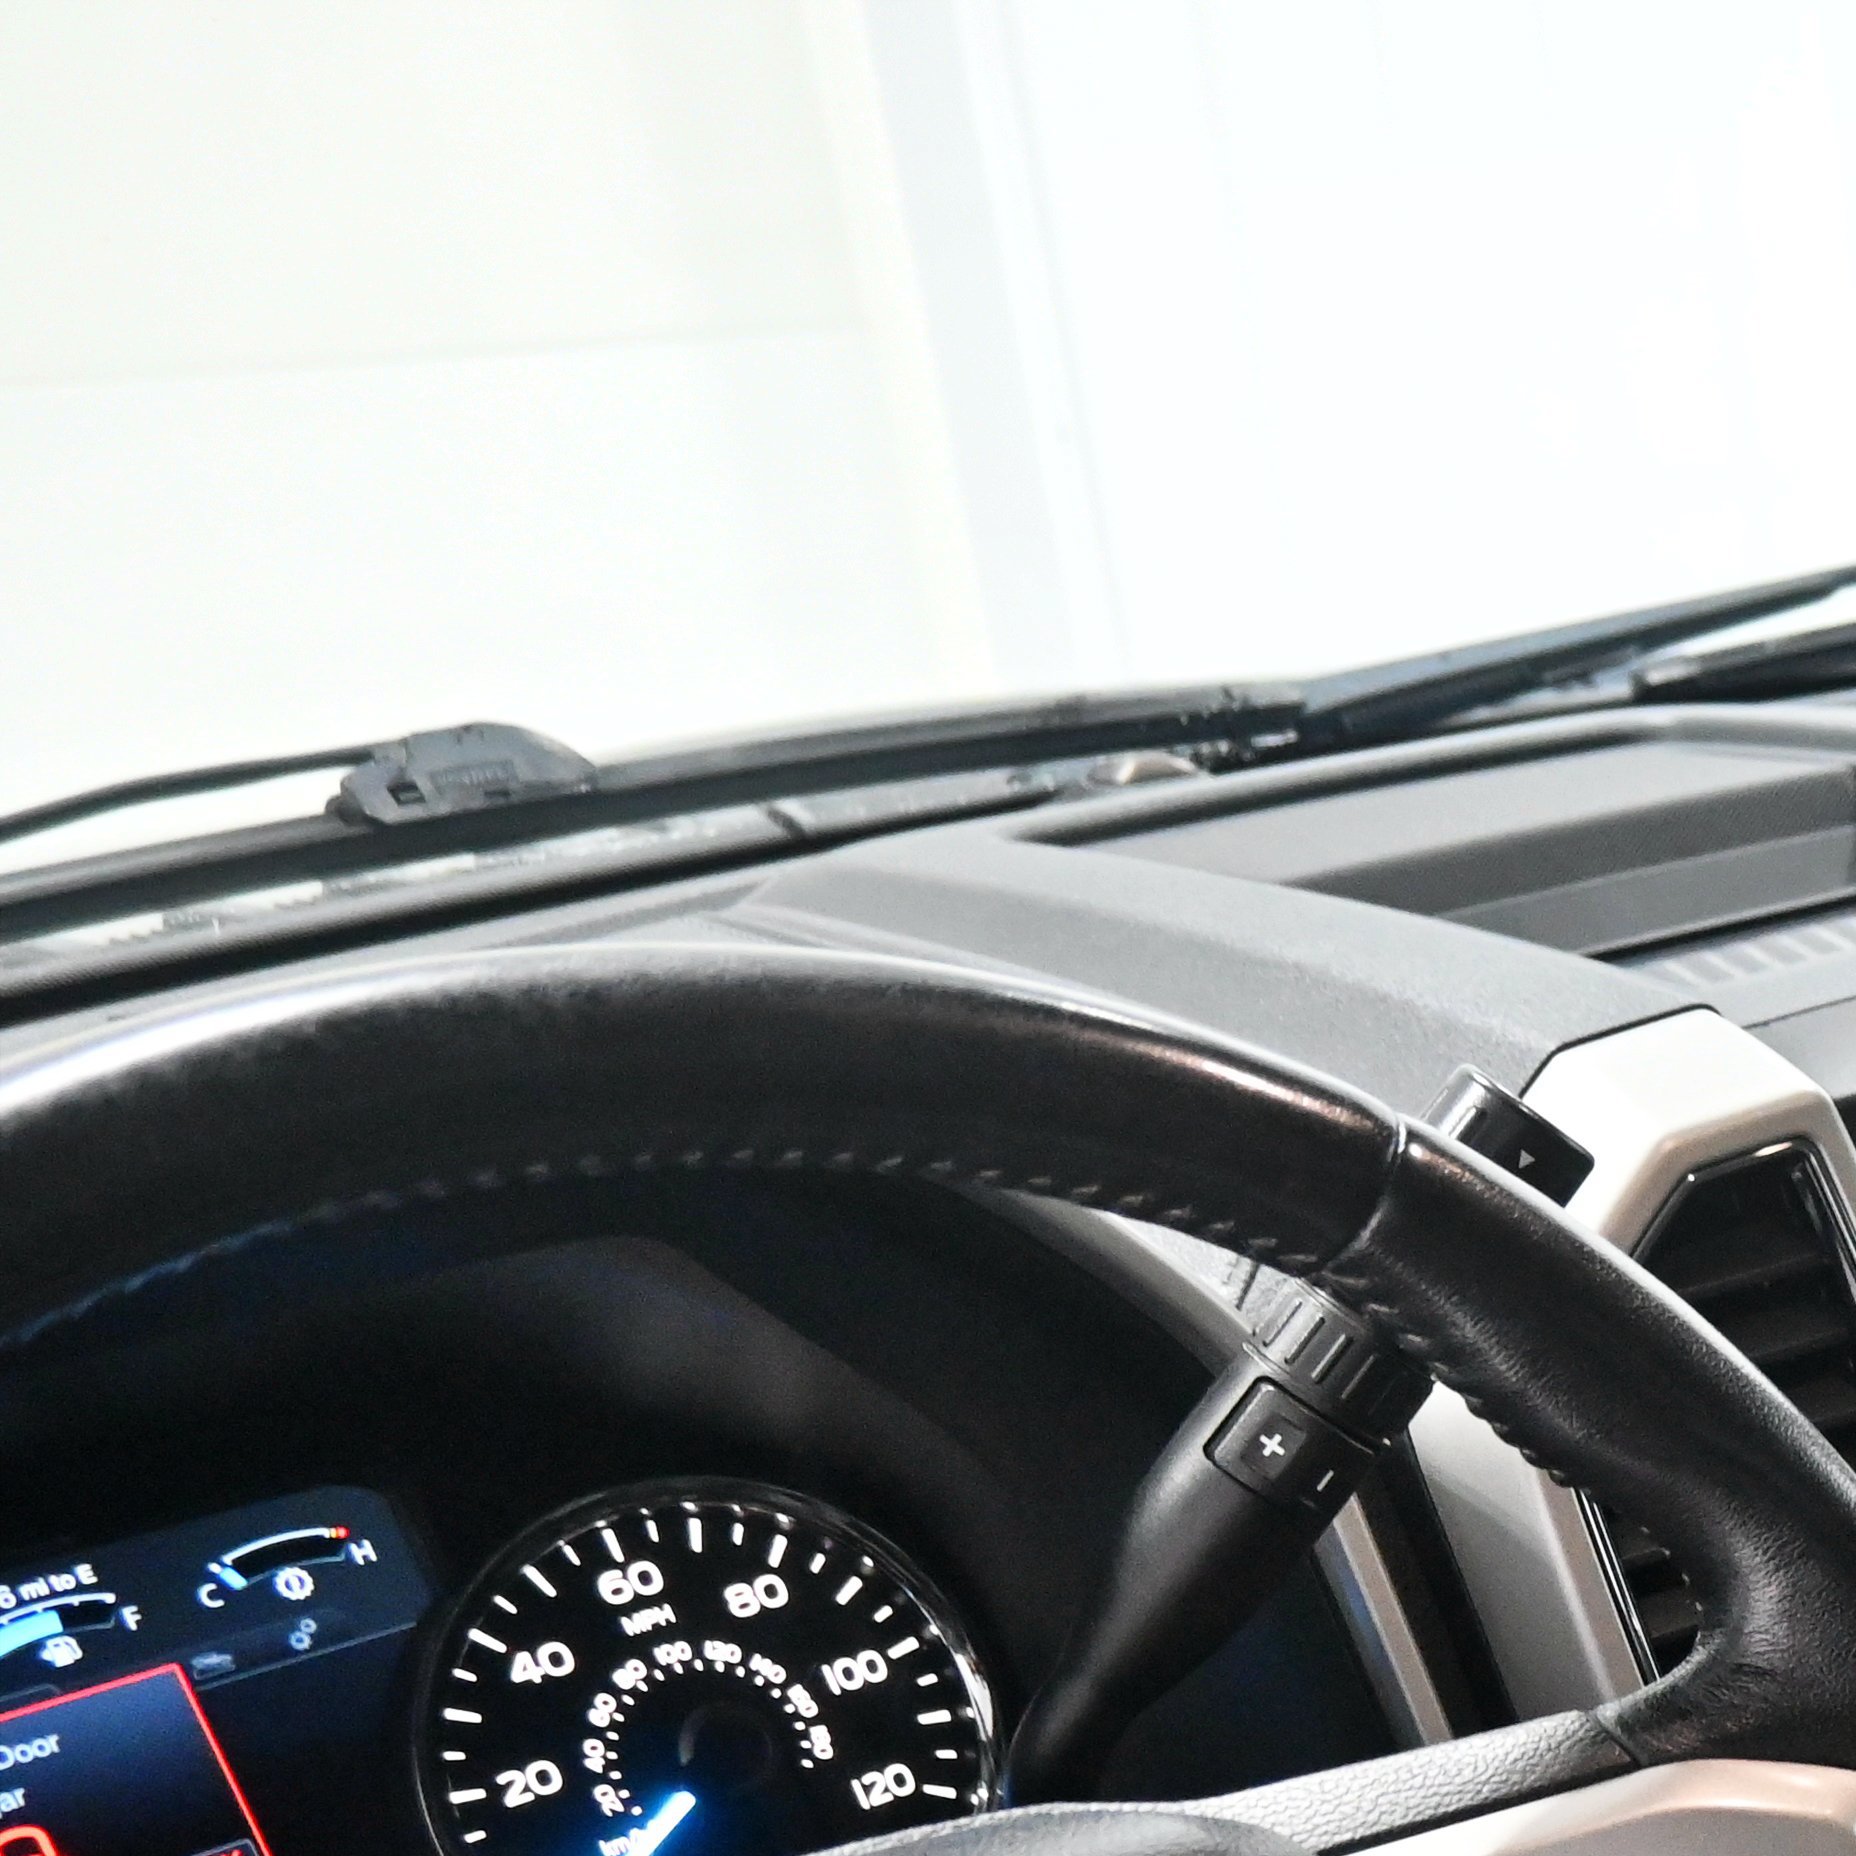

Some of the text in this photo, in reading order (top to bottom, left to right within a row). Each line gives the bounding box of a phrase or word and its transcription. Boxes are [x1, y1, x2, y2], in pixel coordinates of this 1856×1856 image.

[348, 1540, 377, 1565] H
[18, 1576, 51, 1601] mi
[48, 1572, 77, 1592] to
[75, 1563, 98, 1585] E
[198, 1582, 225, 1608] C
[598, 1560, 664, 1606] 60
[723, 1574, 789, 1618] 80
[119, 1604, 142, 1631] F
[619, 1603, 677, 1636] MPH
[510, 1640, 576, 1684] 40
[653, 1640, 693, 1666] 100
[703, 1640, 742, 1664] 120
[612, 1658, 648, 1690] 80
[820, 1649, 888, 1696] 100
[588, 1692, 617, 1728] 60
[582, 1738, 606, 1774] 40
[496, 1758, 563, 1807] 20
[593, 1783, 625, 1817] 20
[851, 1762, 916, 1810] 120
